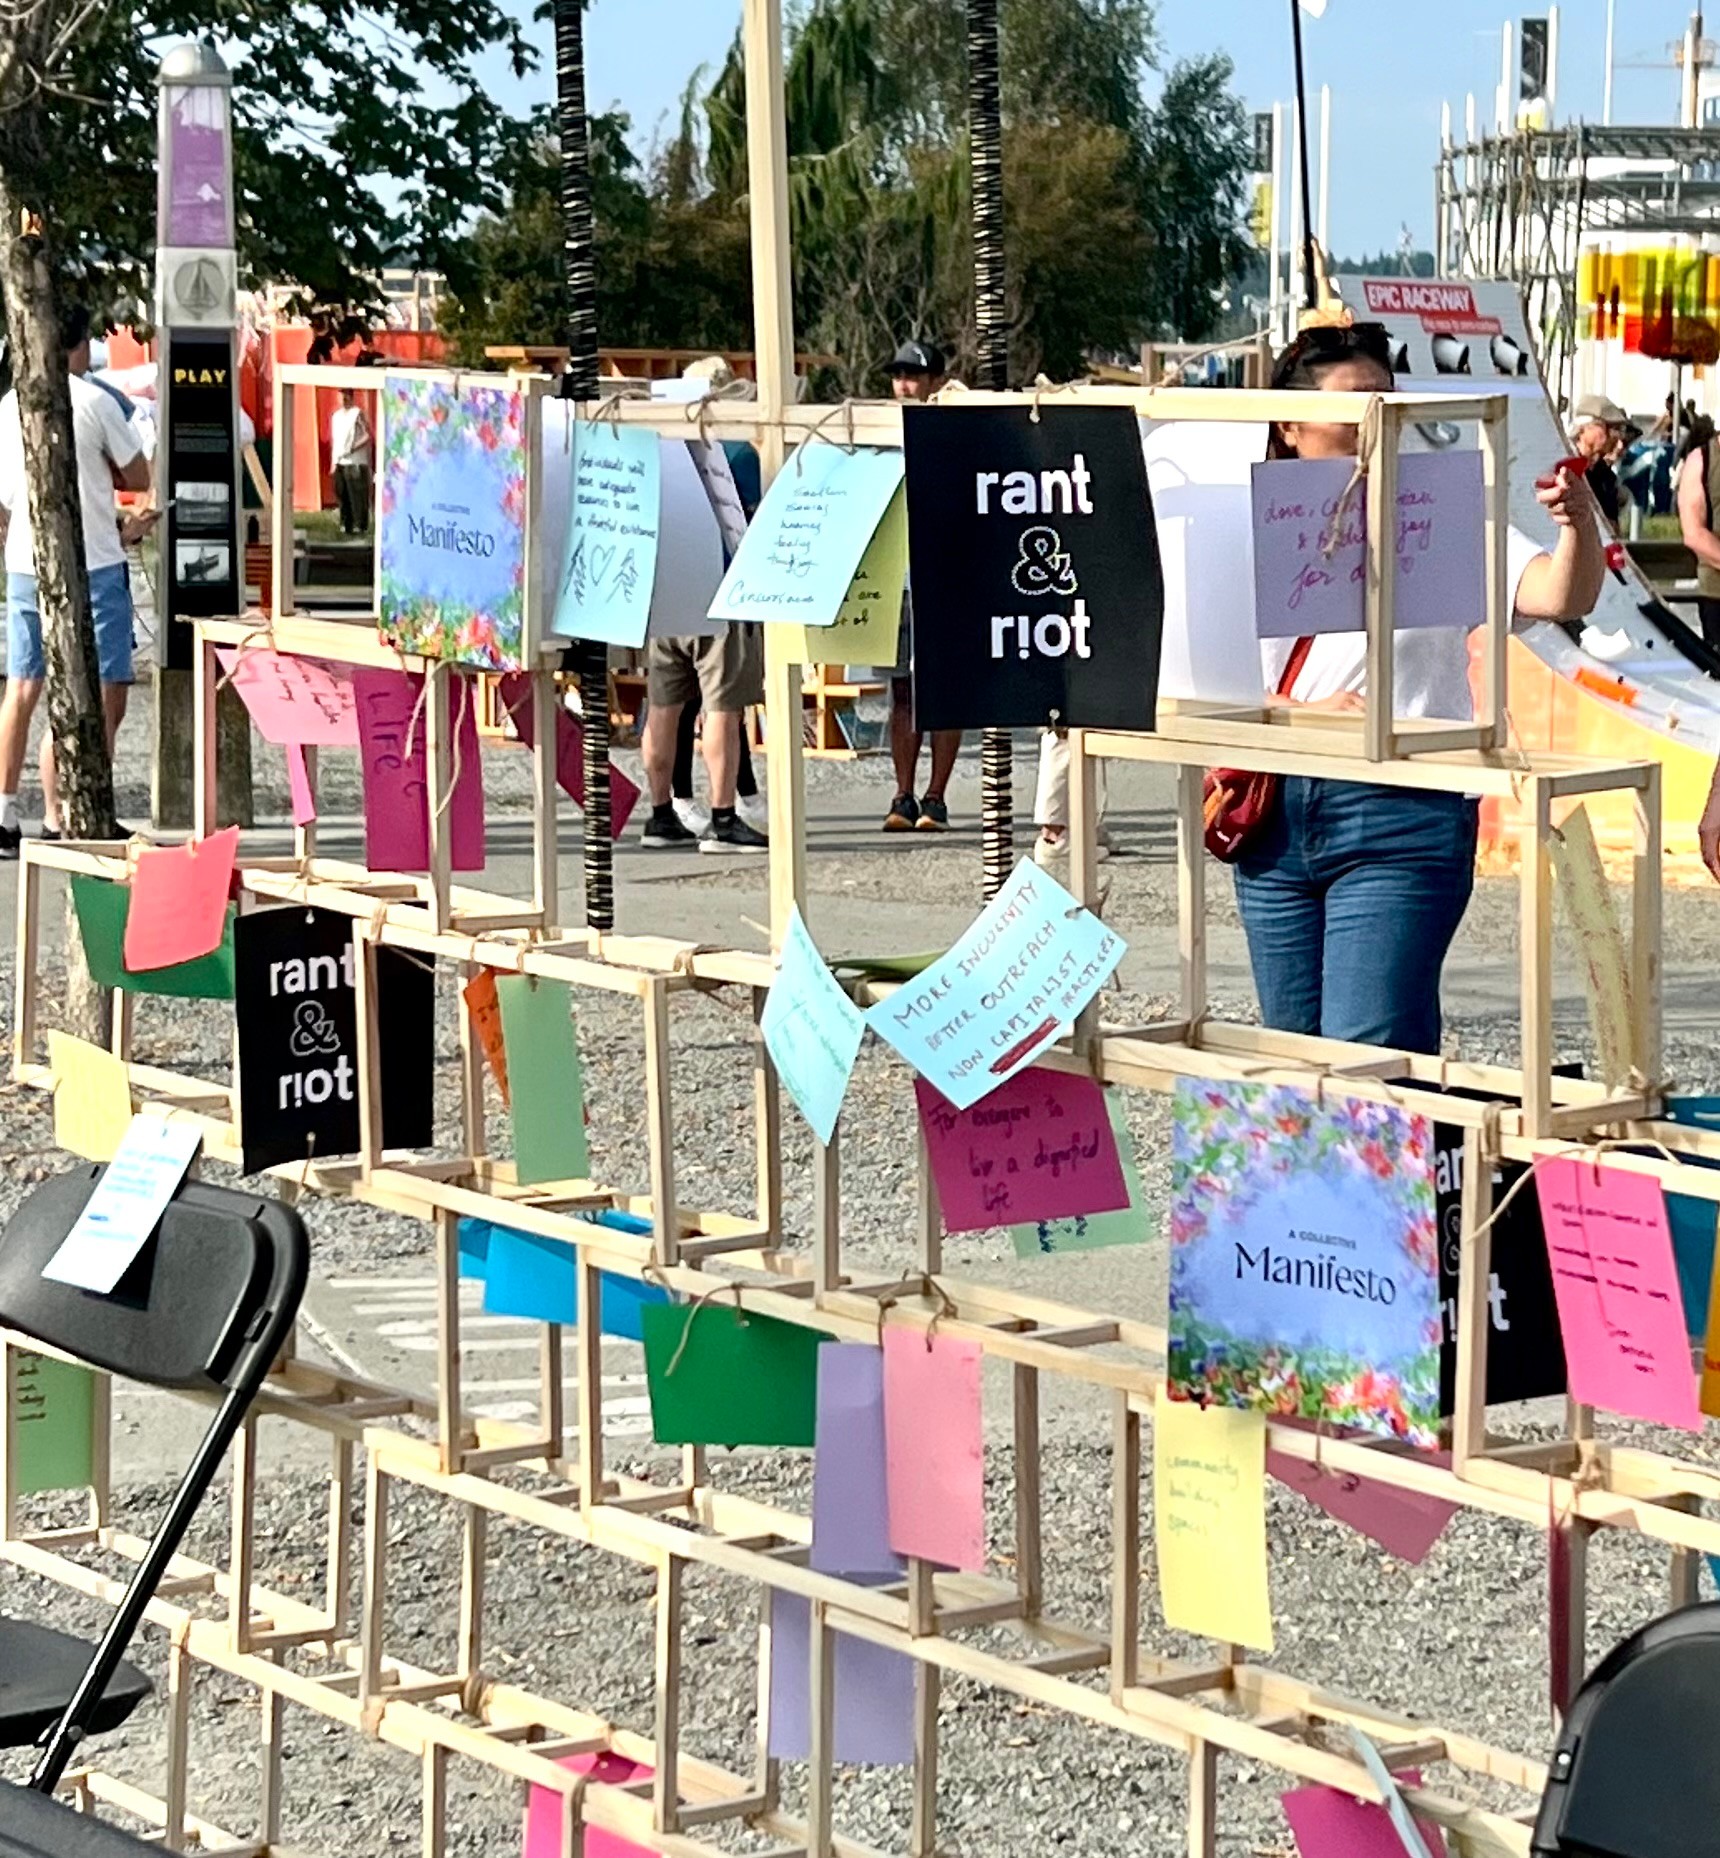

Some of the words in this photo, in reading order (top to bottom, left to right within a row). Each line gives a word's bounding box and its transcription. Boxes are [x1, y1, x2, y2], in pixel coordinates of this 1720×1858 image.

[1366, 283, 1401, 309] EPIC
[1401, 286, 1470, 311] RACEWAY
[173, 368, 226, 384] PLAY
[976, 453, 1094, 515] rant
[407, 512, 496, 558] Manifesto
[1010, 525, 1079, 595] &
[269, 943, 357, 997] rant
[980, 919, 1058, 1011] OUTREACH
[288, 1000, 341, 1057] &
[892, 973, 953, 1030] MORE
[947, 1049, 985, 1081] NON
[990, 949, 1079, 1047] CAPITALIST
[1288, 1229, 1297, 1239] A
[1298, 1230, 1357, 1251] COLLECTIVE
[1234, 1241, 1397, 1306] Manifesto
